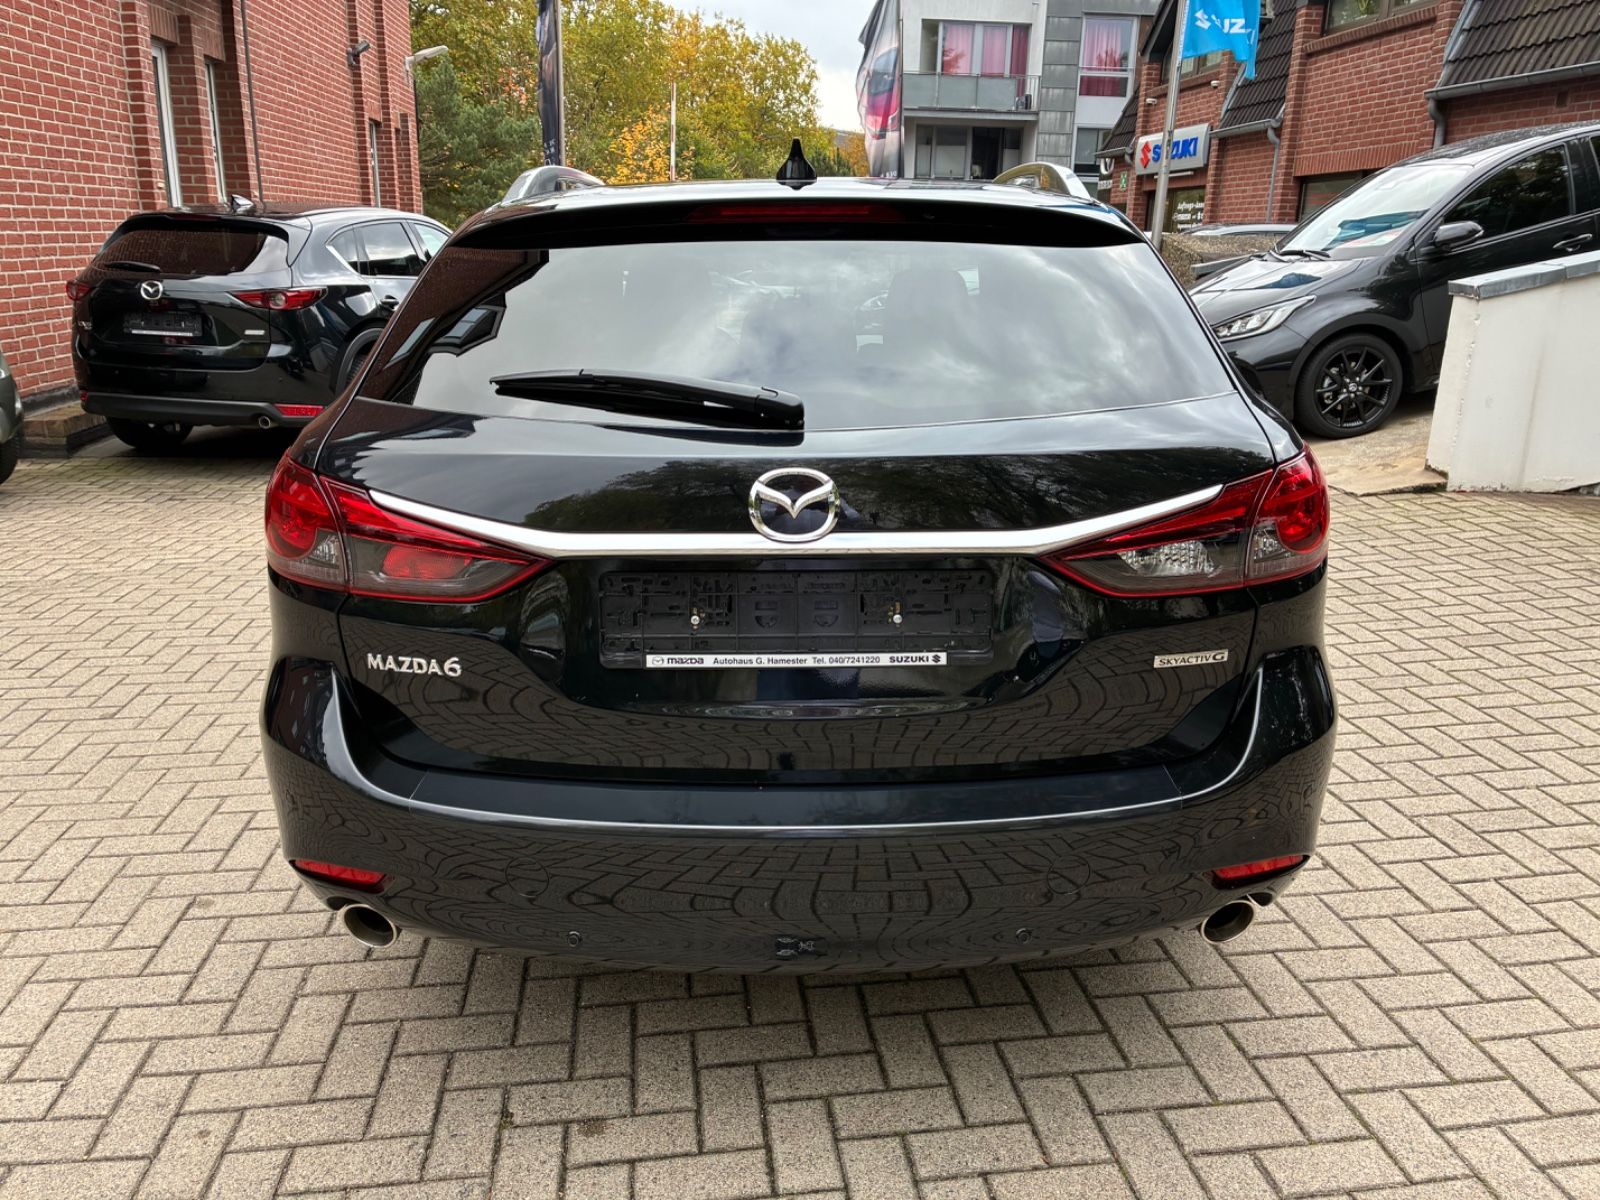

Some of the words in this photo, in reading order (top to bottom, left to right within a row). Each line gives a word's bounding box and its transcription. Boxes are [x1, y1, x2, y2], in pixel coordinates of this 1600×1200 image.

[1152, 137, 1199, 162] SZUKI
[667, 657, 704, 665] mazda
[713, 657, 753, 665] Autohaus
[755, 657, 765, 665] G.
[767, 656, 807, 665] Hamester
[812, 656, 826, 665] Tel.
[828, 656, 881, 664] 040/7241220
[889, 655, 929, 663] SUZUKI
